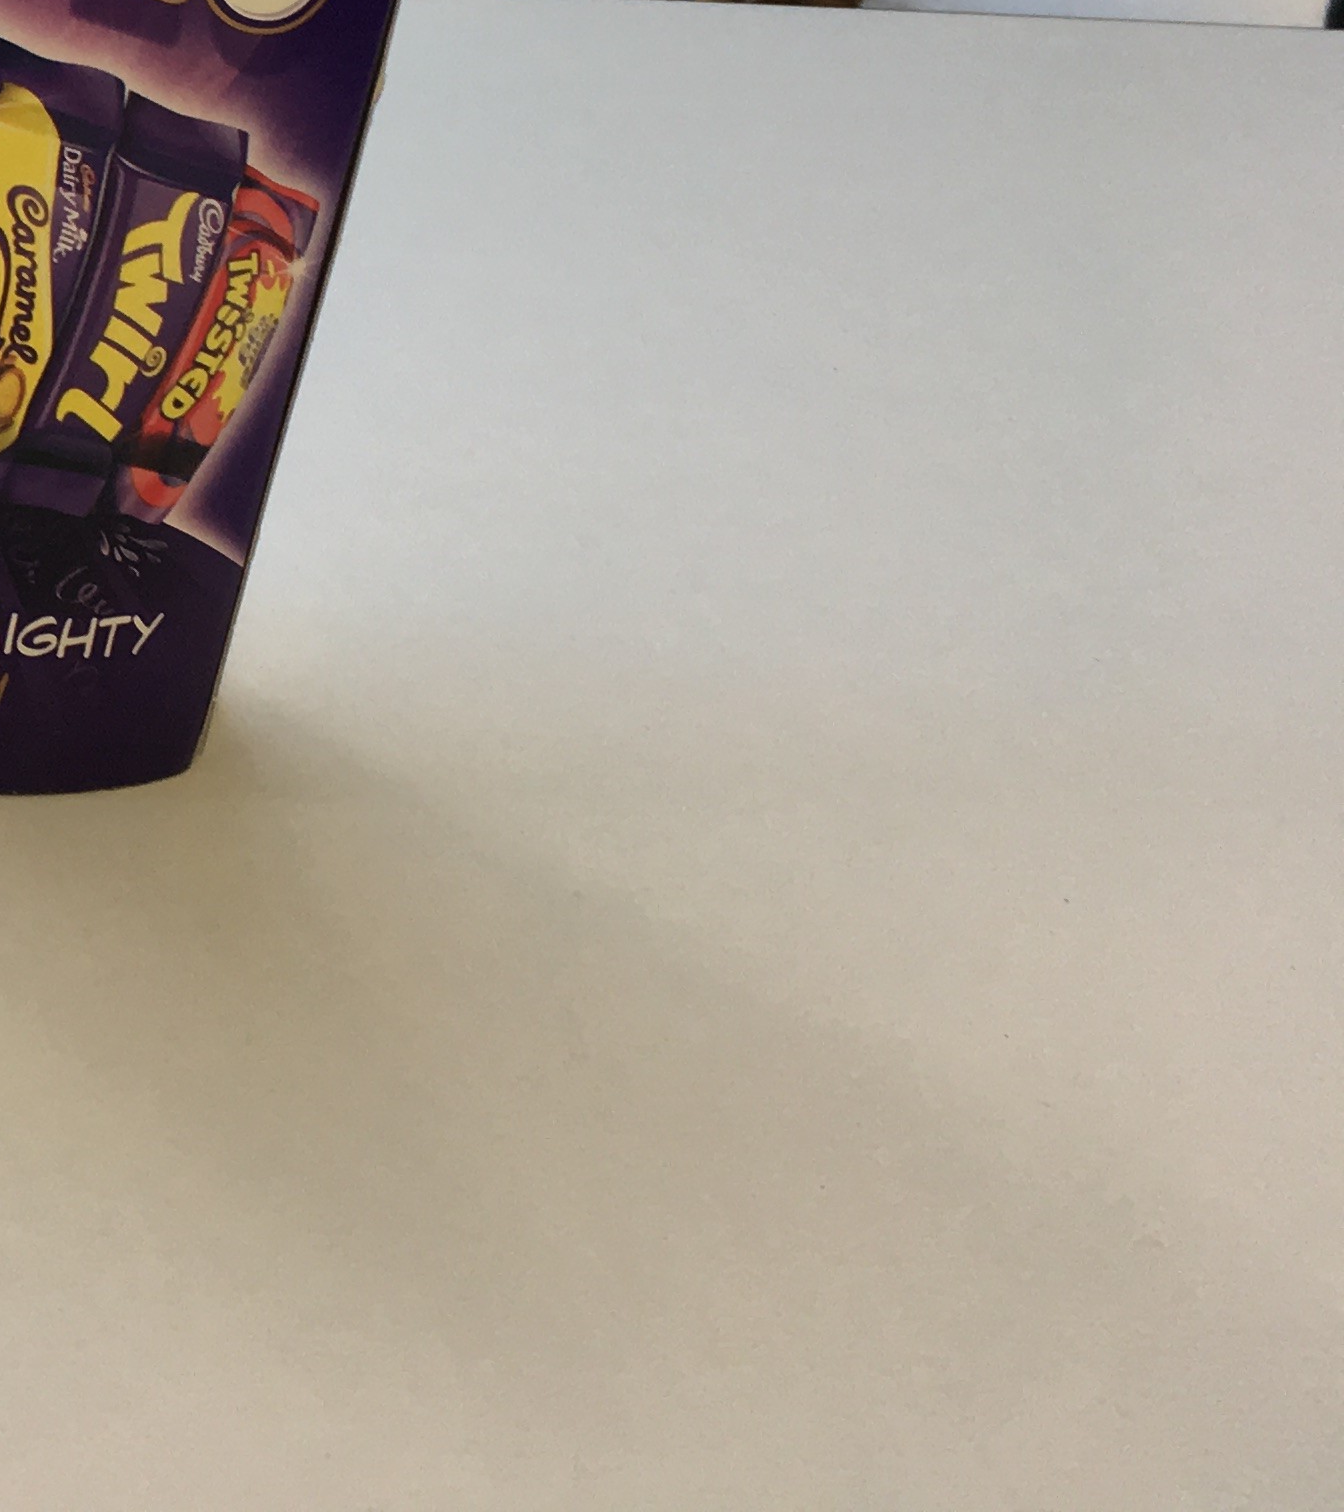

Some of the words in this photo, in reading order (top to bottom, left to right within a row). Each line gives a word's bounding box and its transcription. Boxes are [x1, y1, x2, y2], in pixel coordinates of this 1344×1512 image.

[59, 146, 82, 208] Dairy
[6, 184, 51, 364] Caramel
[189, 197, 226, 283] Cadbury
